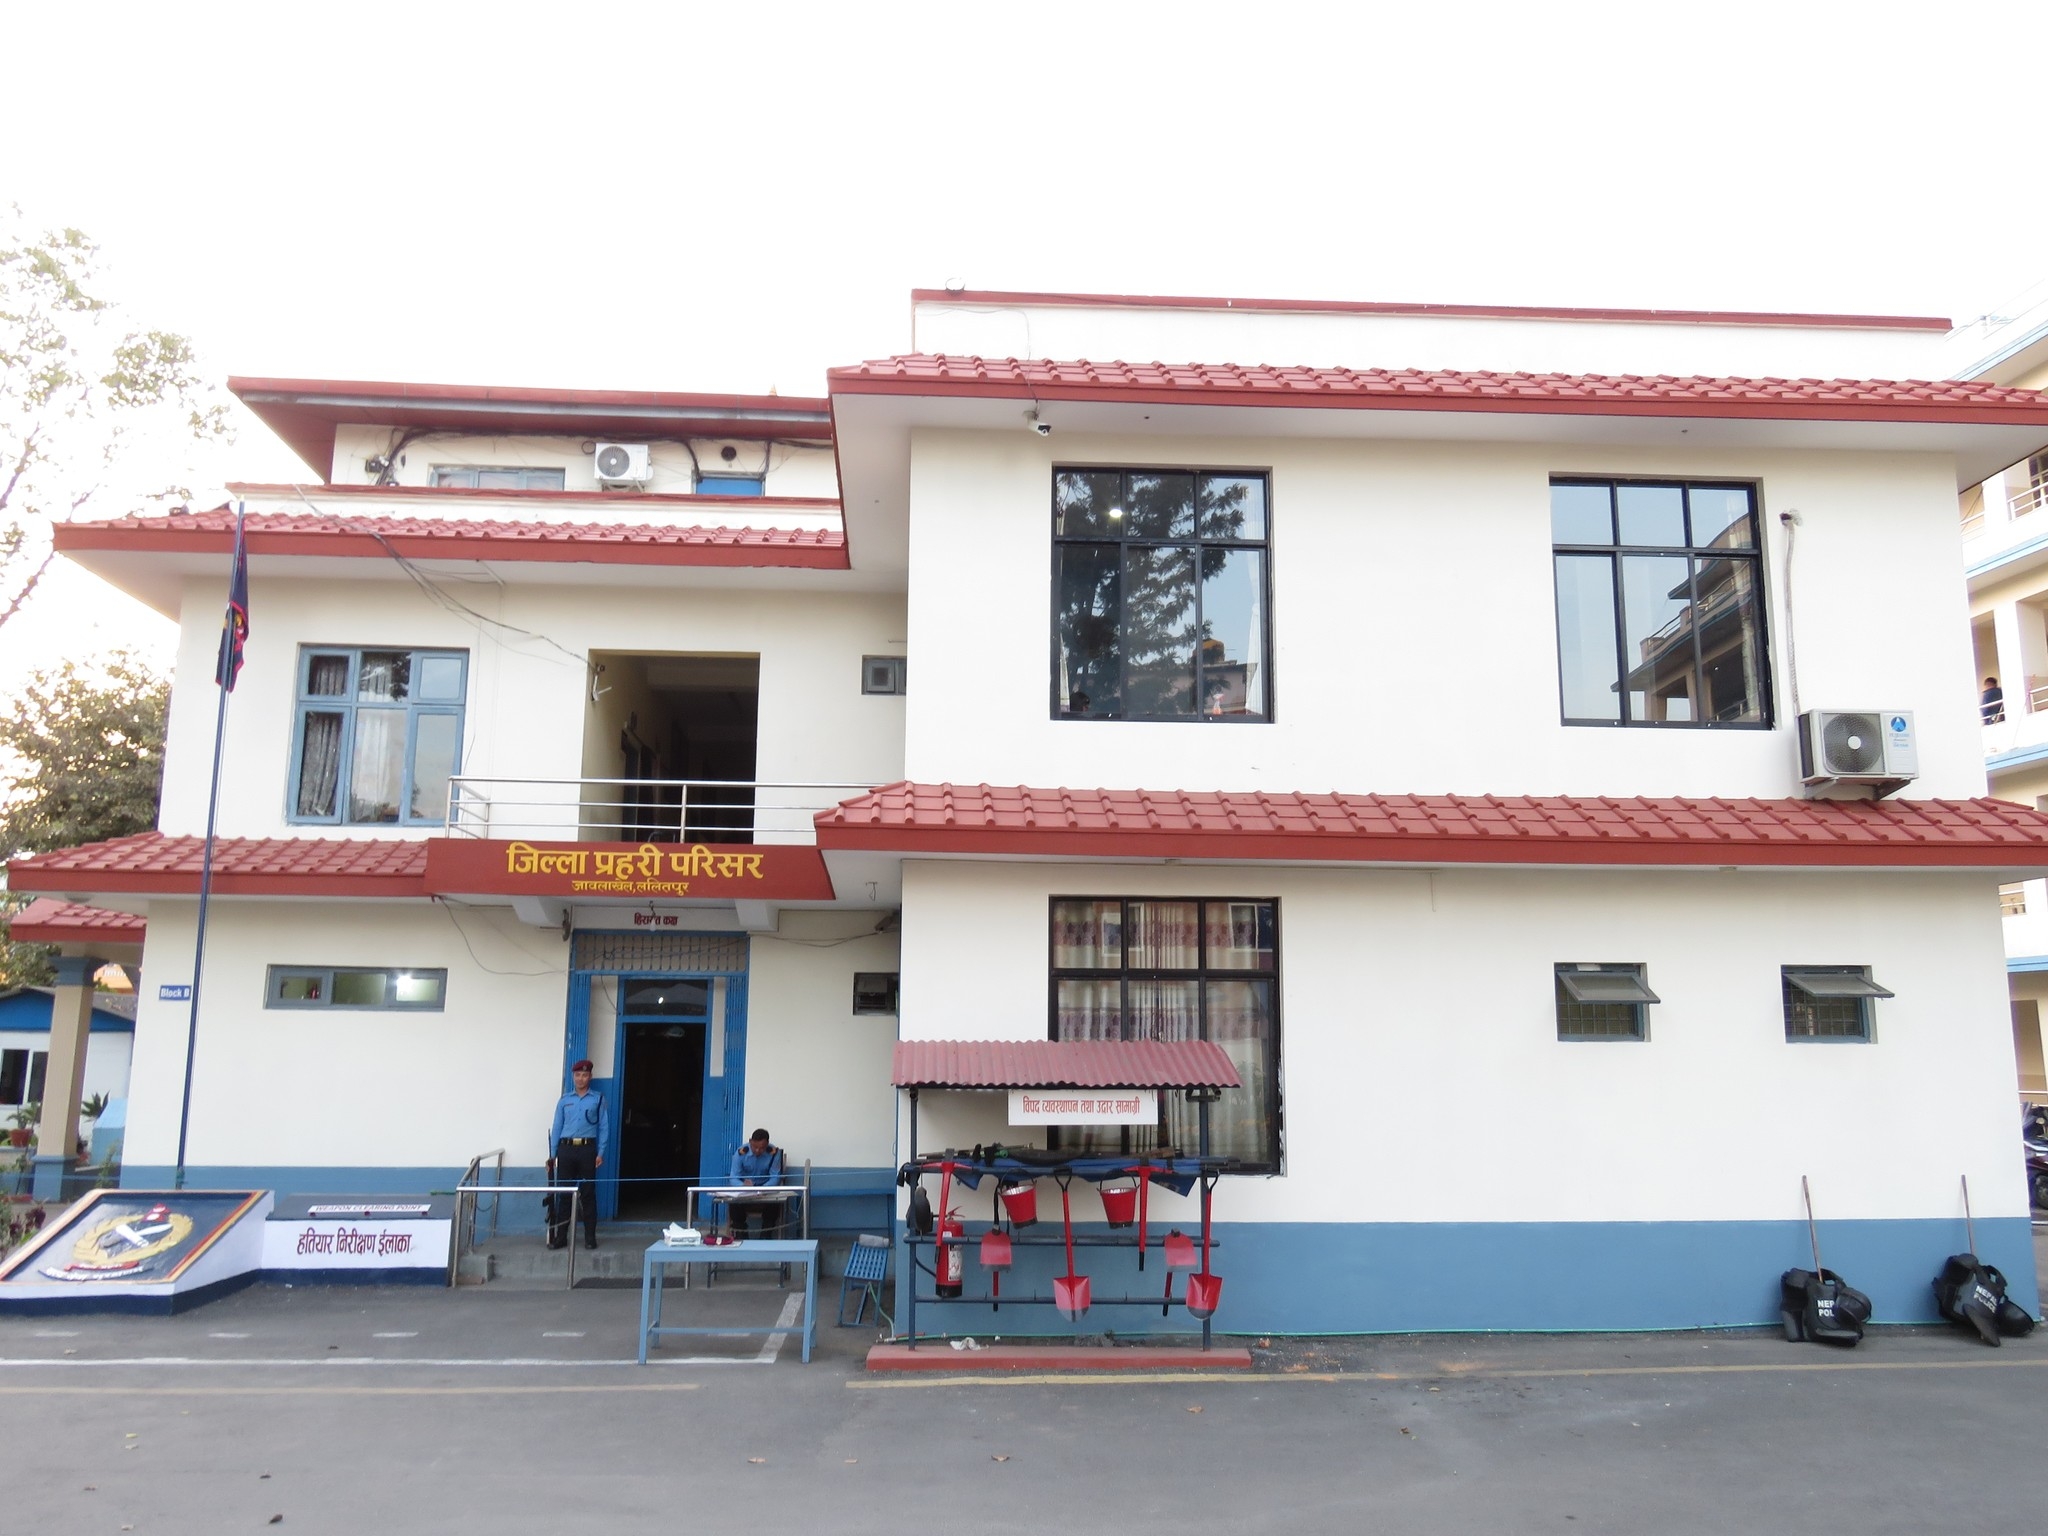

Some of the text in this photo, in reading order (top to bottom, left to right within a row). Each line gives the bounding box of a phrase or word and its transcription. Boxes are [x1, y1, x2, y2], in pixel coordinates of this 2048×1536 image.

[506, 842, 764, 880] जिल्ला प्रहरी परिसर
[160, 987, 190, 998] Block B
[1080, 1099, 1094, 1114] तथा
[297, 1227, 334, 1255] हतियार
[336, 1227, 376, 1255] निरीक्षण
[1817, 1299, 1835, 1308] NEP
[1818, 1309, 1835, 1317] POL
